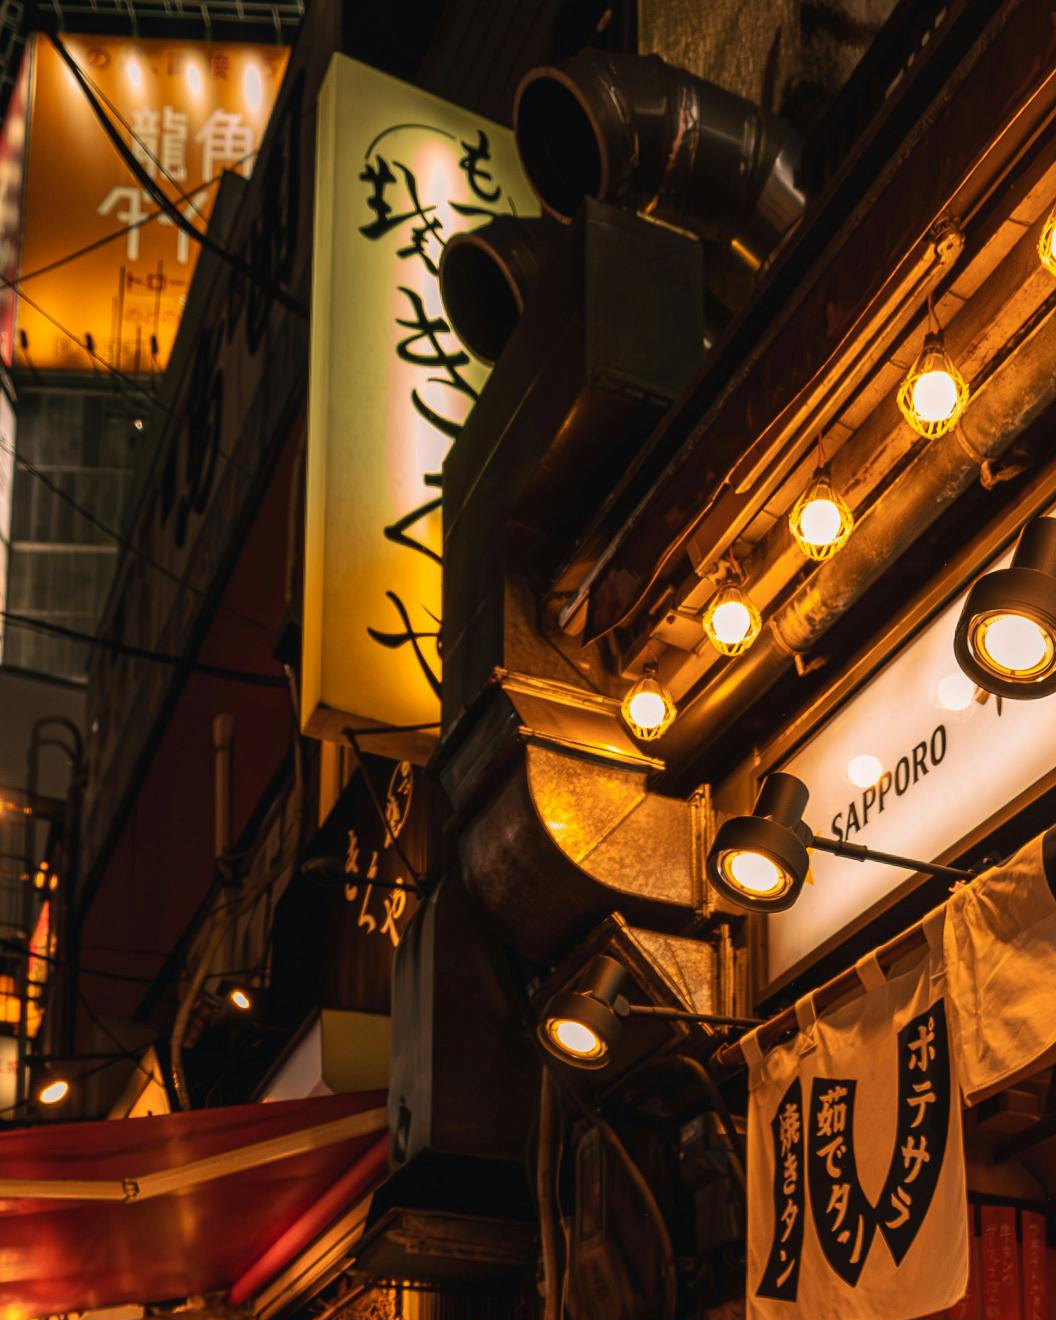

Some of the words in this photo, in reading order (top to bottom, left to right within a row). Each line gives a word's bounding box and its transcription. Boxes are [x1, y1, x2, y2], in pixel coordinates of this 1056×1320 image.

[830, 722, 948, 843] SAPPORO
[774, 1103, 802, 1289] 焼きタン
[815, 1085, 866, 1265] 茹でタン
[887, 1015, 938, 1231] ポテサラ
